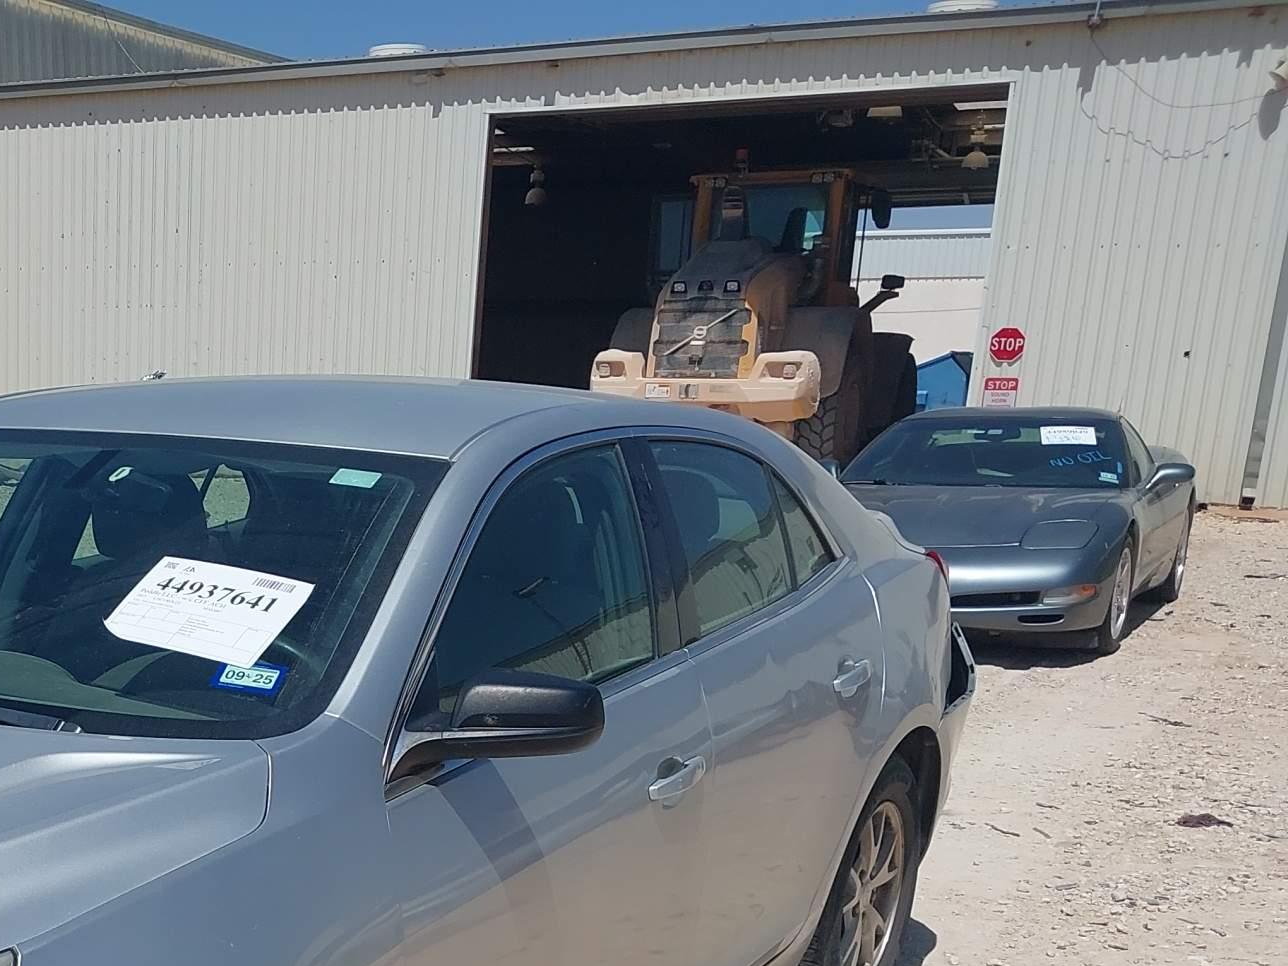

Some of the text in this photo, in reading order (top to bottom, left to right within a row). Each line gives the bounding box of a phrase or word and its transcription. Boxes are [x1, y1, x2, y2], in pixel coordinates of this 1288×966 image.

[991, 338, 1024, 351] STOP
[987, 381, 1016, 390] STOP
[1049, 457, 1074, 467] NO
[156, 577, 279, 612] 44937641
[225, 670, 274, 684] 09 25
